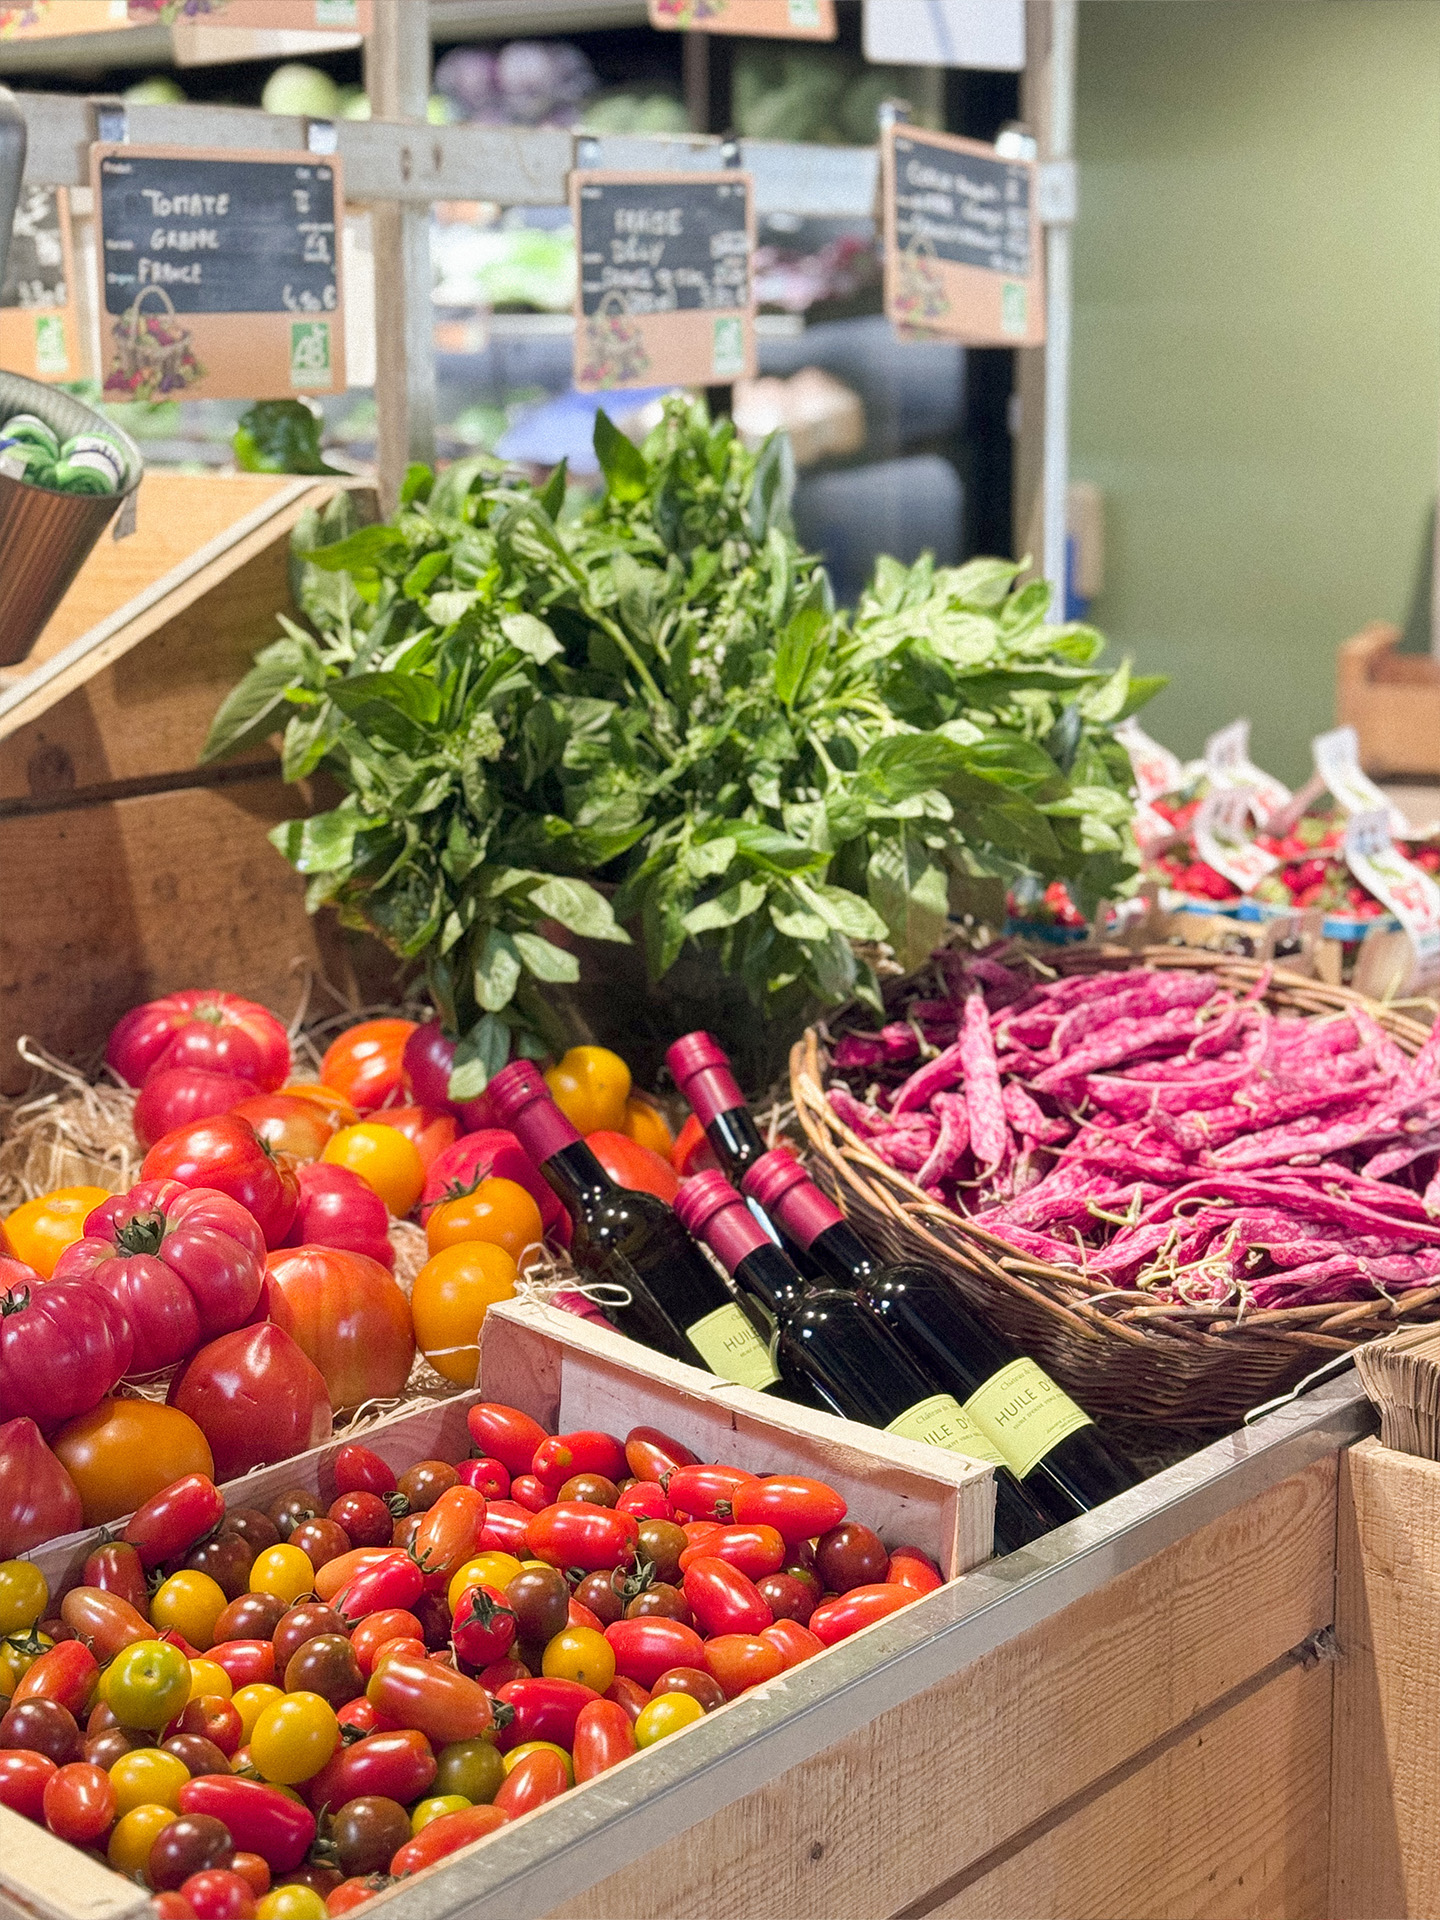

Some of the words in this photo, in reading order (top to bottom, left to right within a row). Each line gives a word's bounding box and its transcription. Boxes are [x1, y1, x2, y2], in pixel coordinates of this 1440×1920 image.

[141, 188, 230, 217] TOMATE
[138, 257, 202, 284] FRANCE
[994, 1388, 1038, 1427] HUILE
[923, 1424, 954, 1445] ILE
